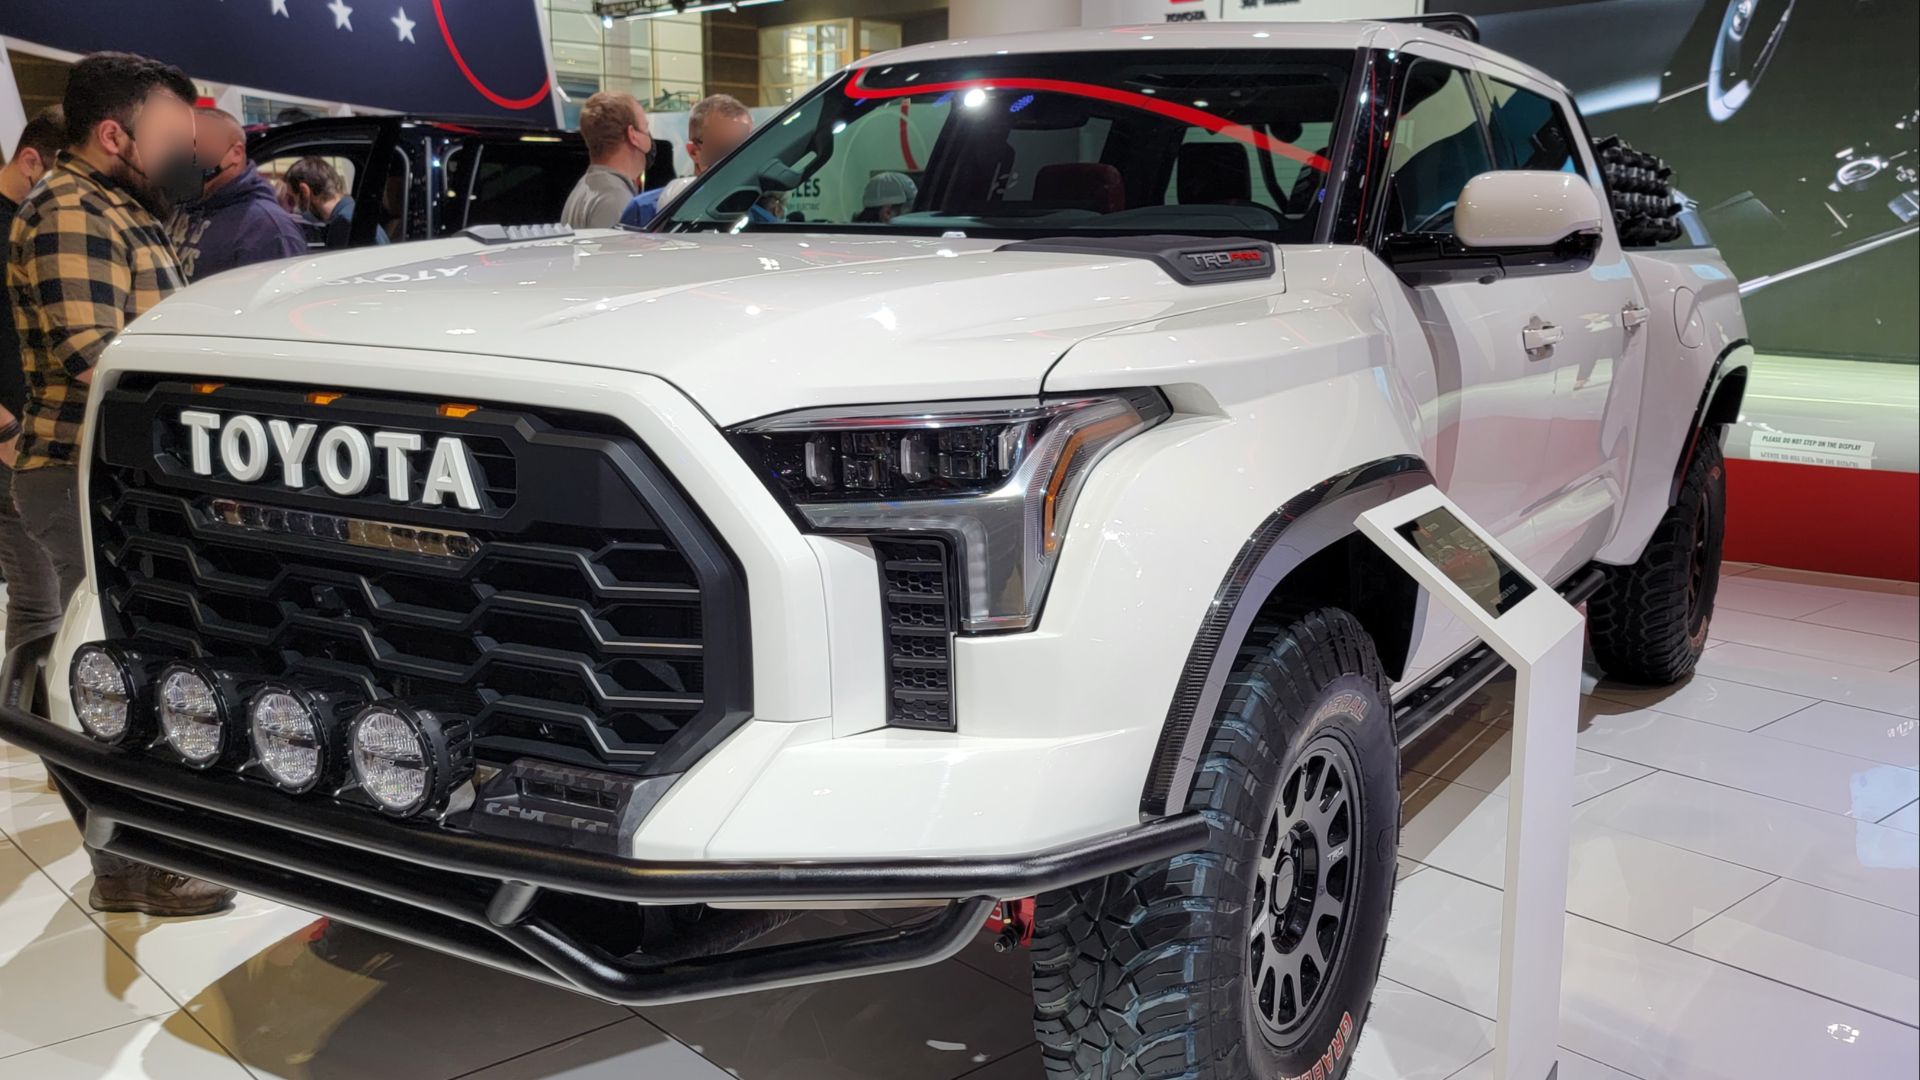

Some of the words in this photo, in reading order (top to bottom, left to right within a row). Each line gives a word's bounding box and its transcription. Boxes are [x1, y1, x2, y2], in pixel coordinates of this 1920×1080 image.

[1165, 10, 1207, 22] TOYOTA
[1761, 435, 1781, 443] PLEASE
[1838, 442, 1861, 451] DISPLAY
[180, 410, 481, 510] TOYOTA
